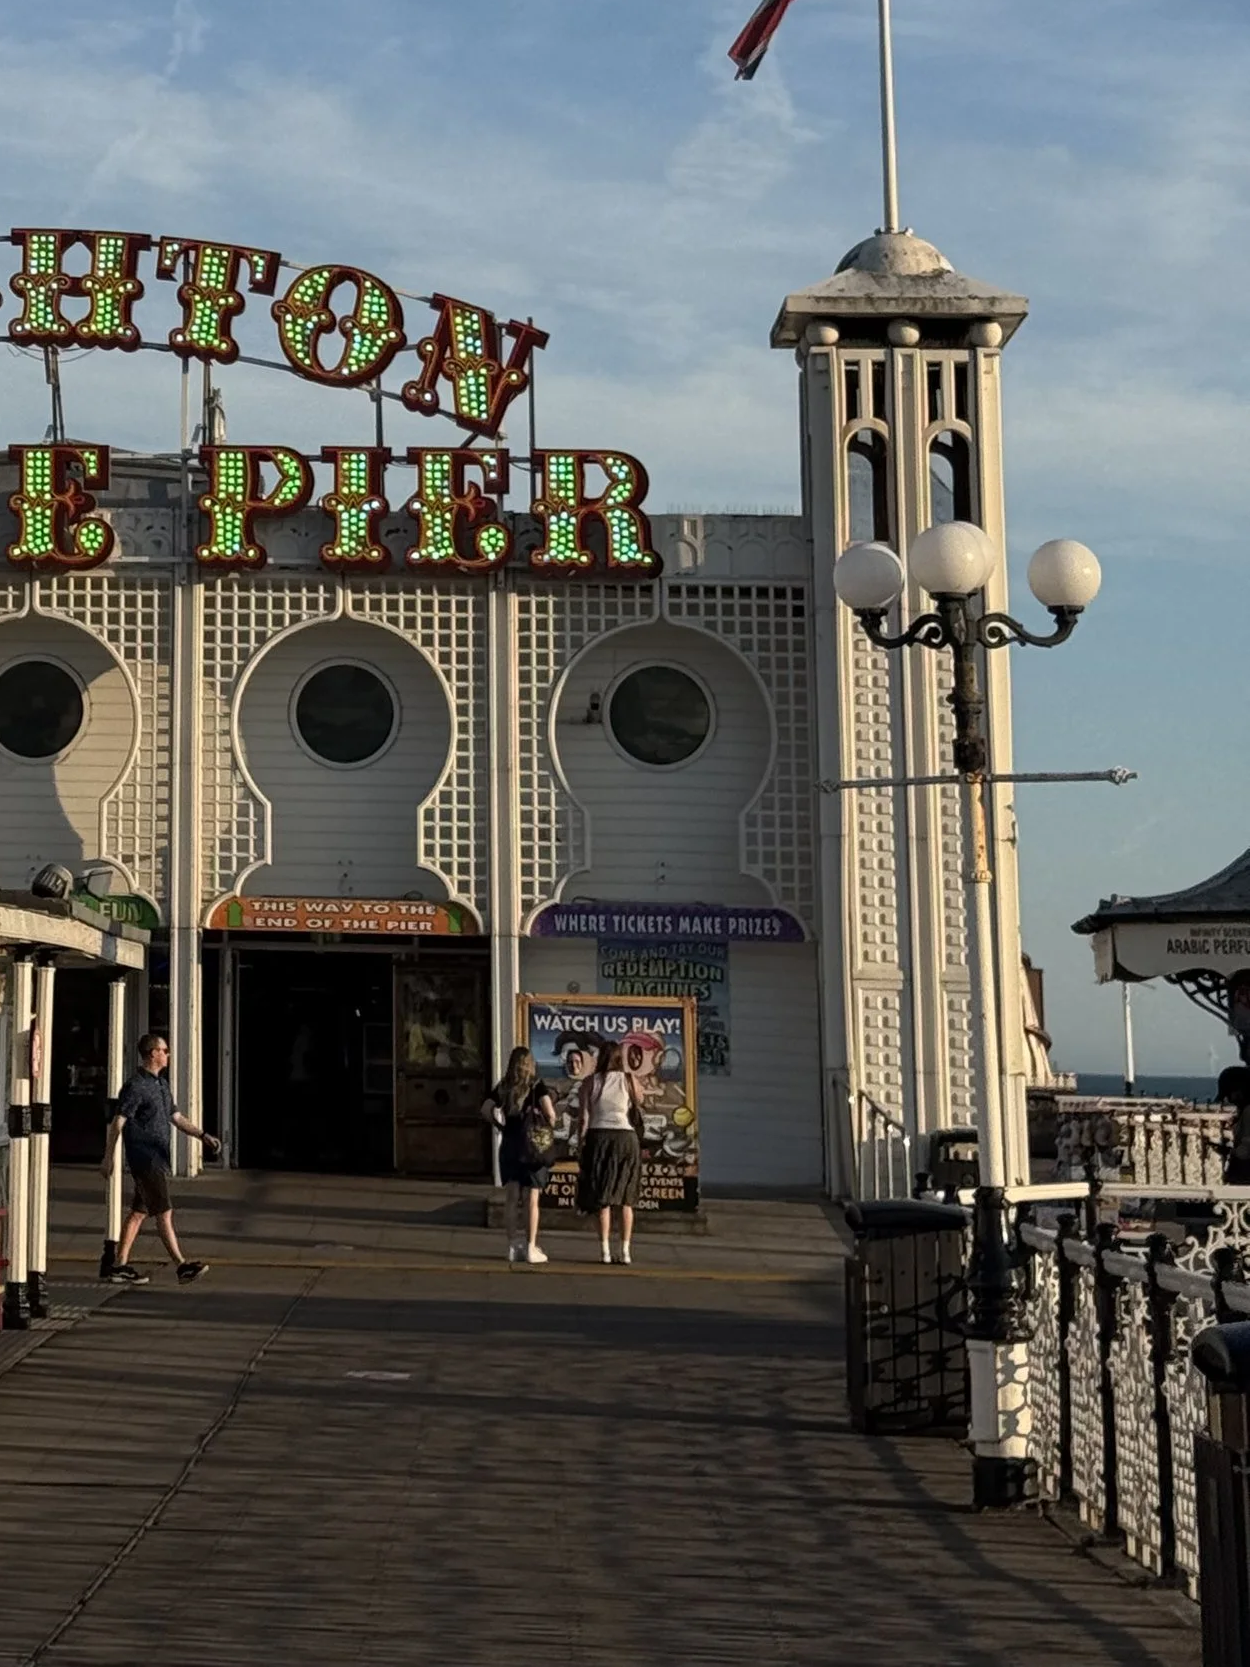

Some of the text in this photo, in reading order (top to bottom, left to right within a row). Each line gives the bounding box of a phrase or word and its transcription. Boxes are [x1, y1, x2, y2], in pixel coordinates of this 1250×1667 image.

[194, 444, 664, 580] PIER
[251, 901, 436, 916] THIS WAY TO THE
[255, 917, 433, 931] END OF THE PIER
[554, 914, 782, 936] WHERE TICKETS MAKE PRIZES
[640, 944, 668, 960] AND
[672, 943, 694, 955] TRY
[698, 943, 726, 959] OUR
[1166, 938, 1210, 955] ARABIC
[602, 959, 723, 982] REDEMPTION
[616, 981, 711, 1000] MACHINES
[534, 1014, 598, 1032] WATCH
[603, 1015, 629, 1032] US
[632, 1018, 681, 1034] PLAY!
[649, 1176, 684, 1187] EVENTS
